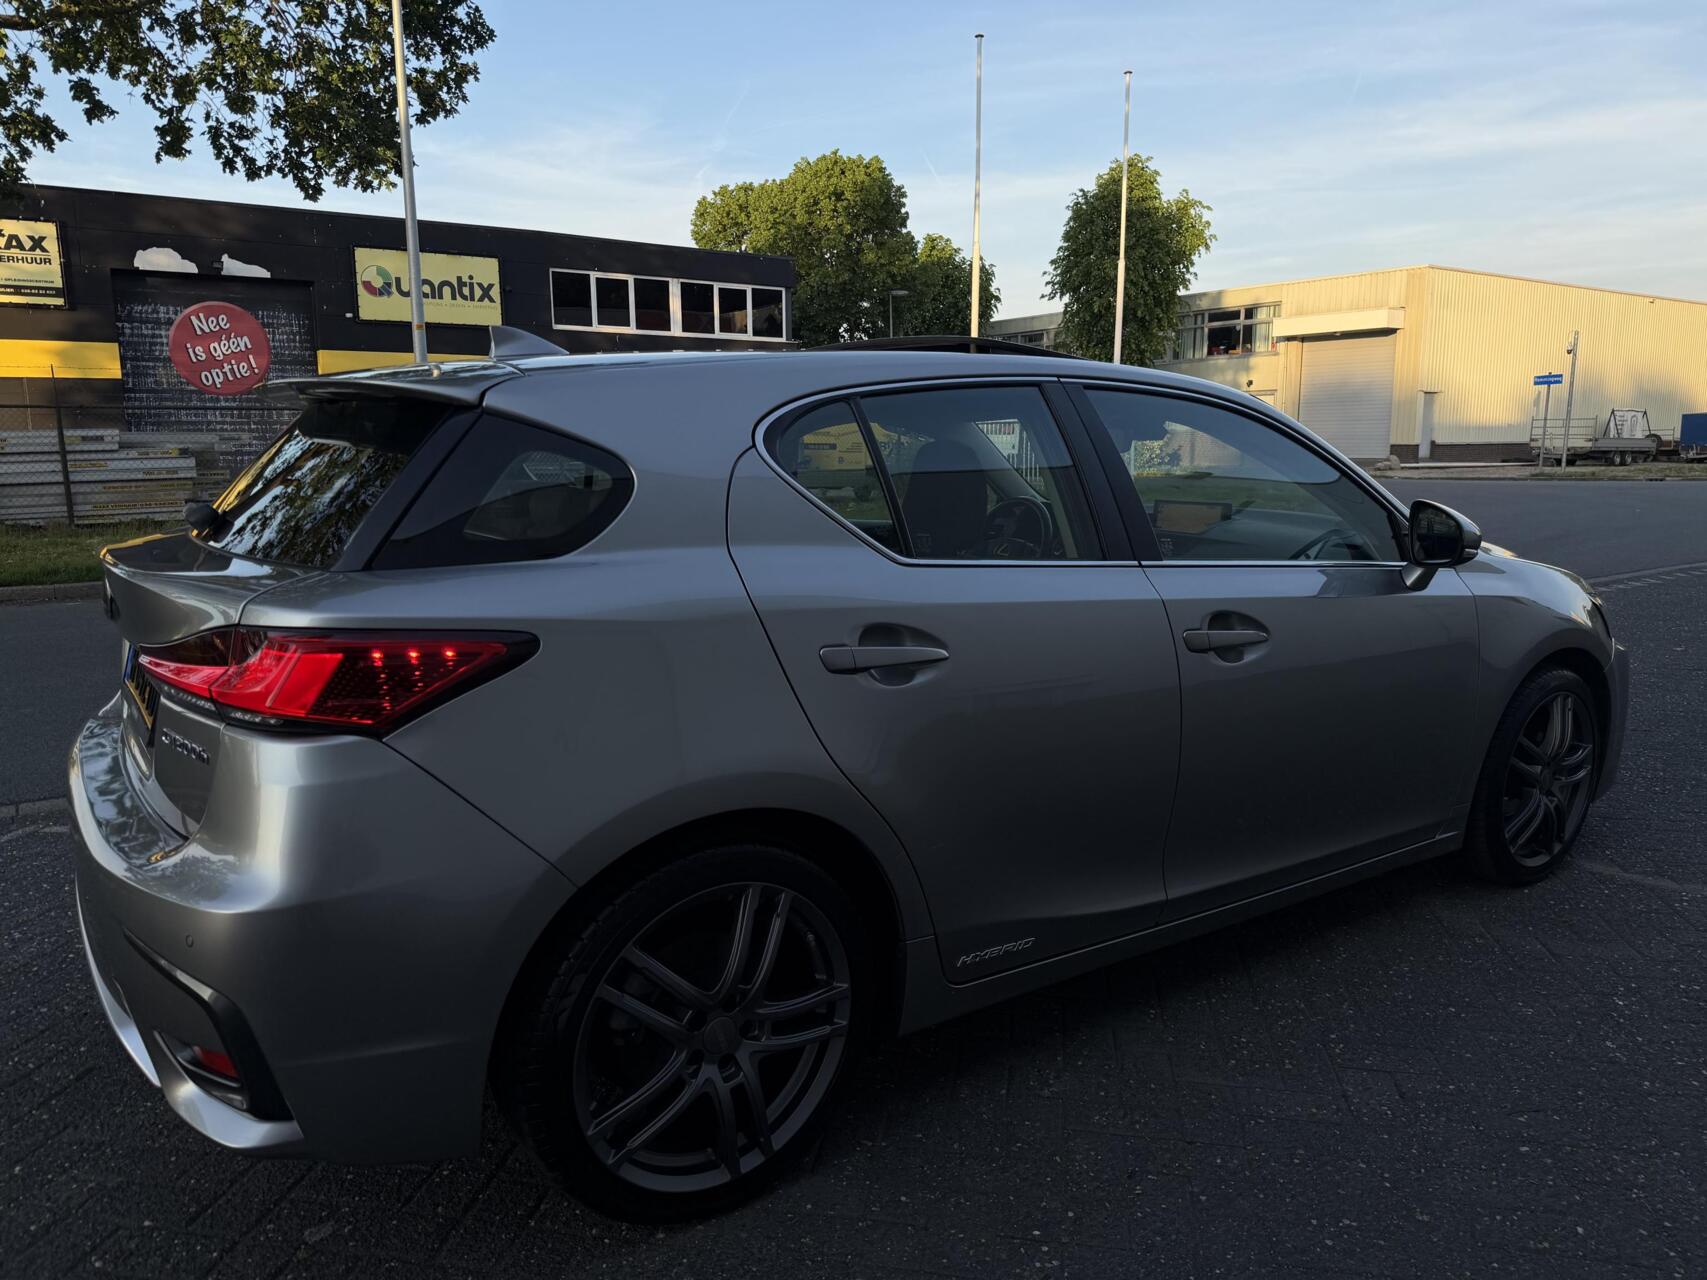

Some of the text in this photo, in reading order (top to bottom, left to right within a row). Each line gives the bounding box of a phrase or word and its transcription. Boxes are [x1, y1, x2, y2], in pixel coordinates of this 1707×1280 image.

[190, 312, 230, 335] Nee
[186, 332, 252, 362] is géén
[201, 354, 259, 388] optie!
